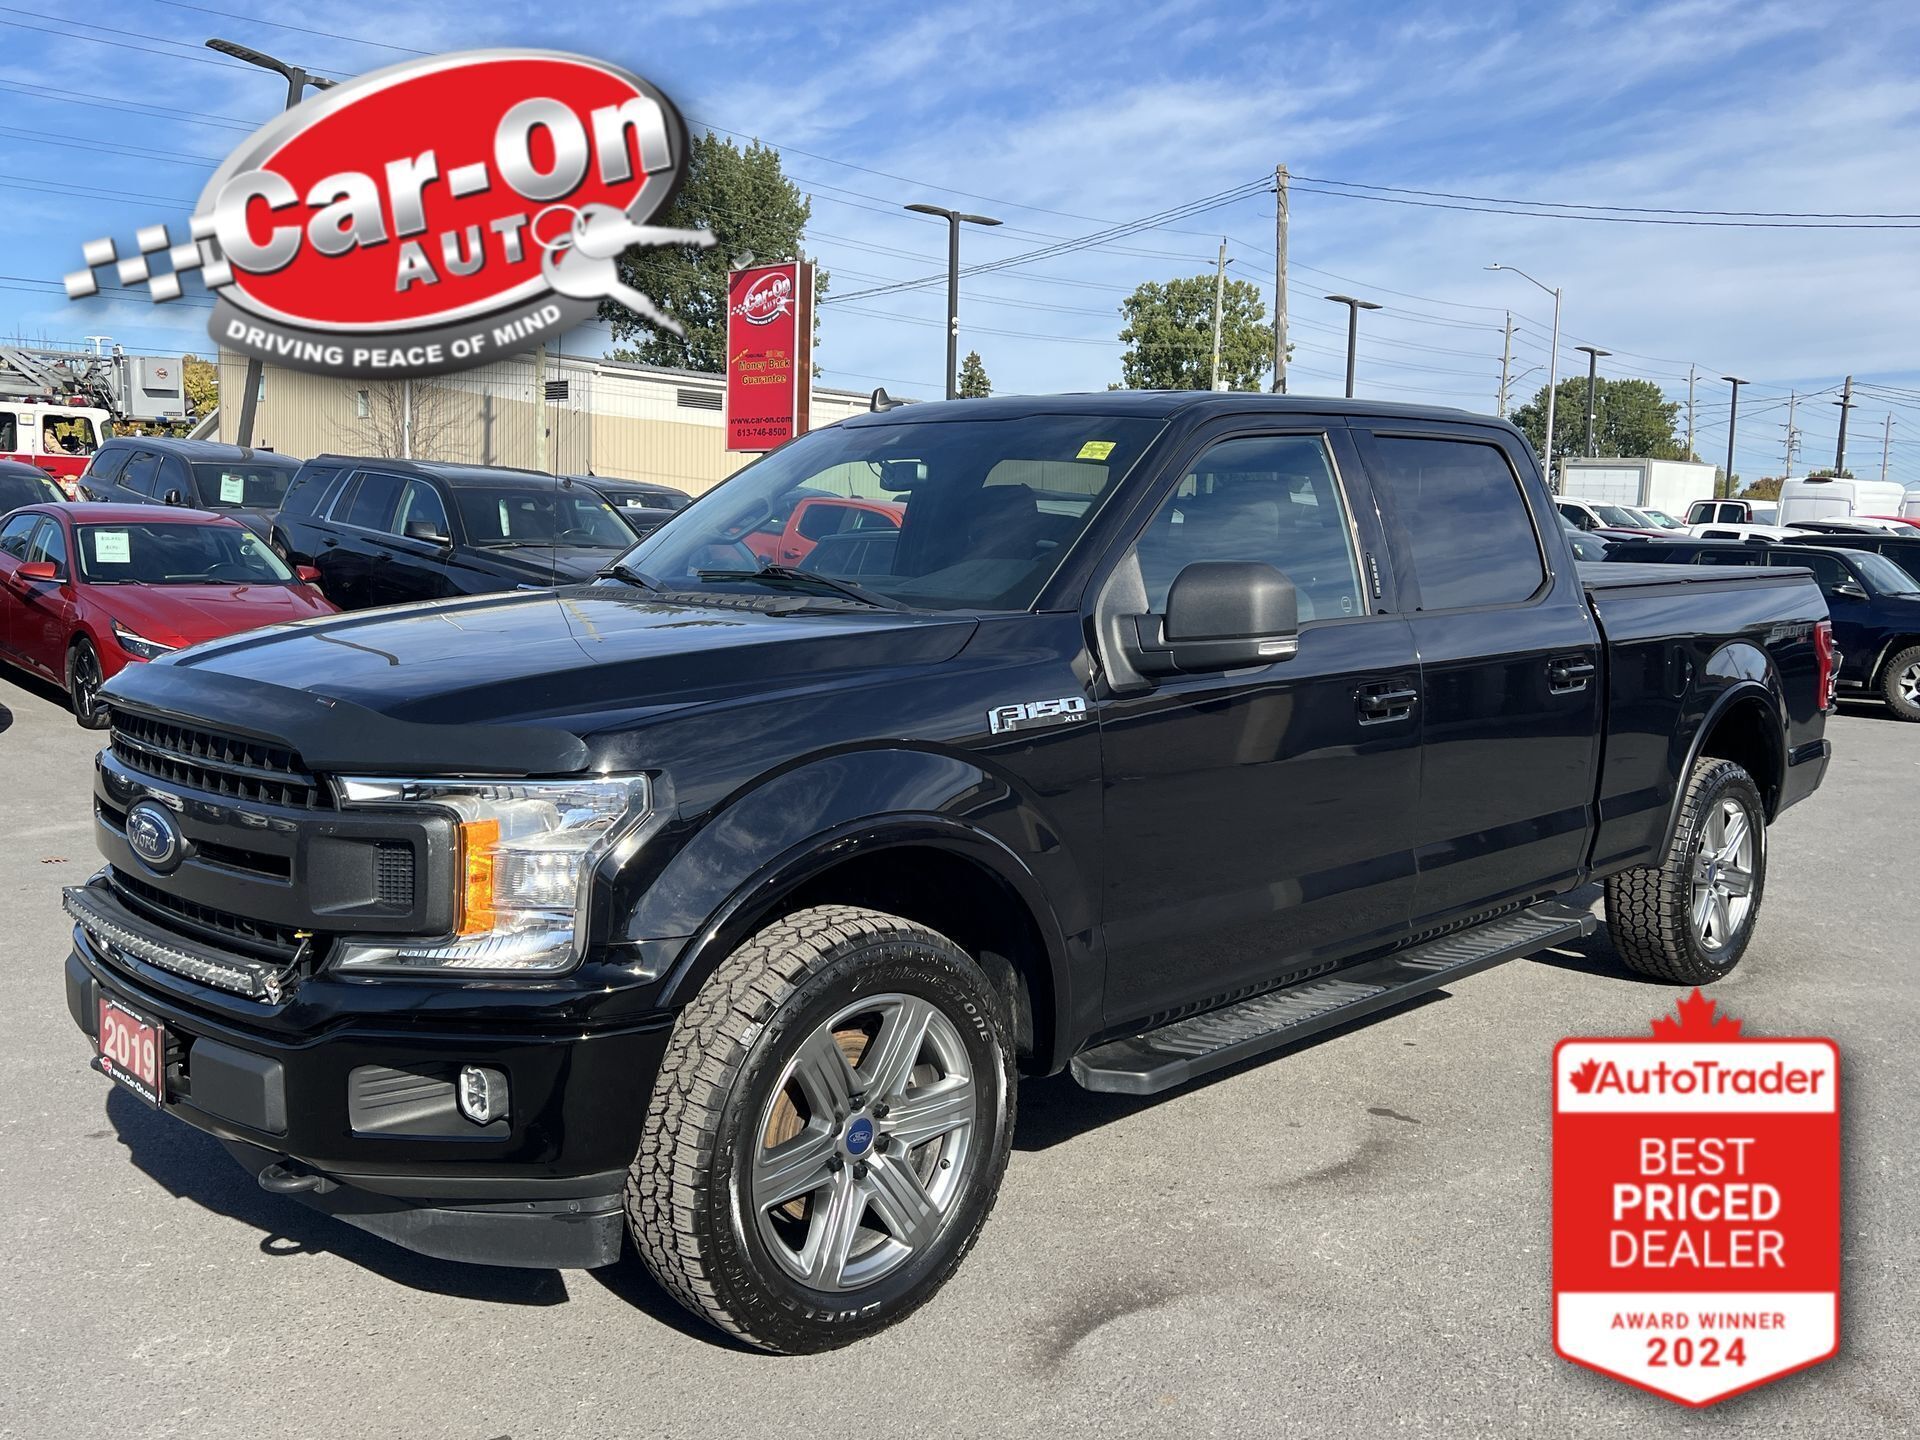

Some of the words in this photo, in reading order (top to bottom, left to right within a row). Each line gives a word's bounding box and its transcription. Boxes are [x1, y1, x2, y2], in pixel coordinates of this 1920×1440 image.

[744, 279, 791, 312] Car-On
[739, 361, 766, 372] Money
[768, 358, 790, 369] Back
[742, 374, 786, 385] Guarantee
[730, 416, 792, 424] www.car-on.com
[737, 428, 787, 437] 613-746-8500
[1064, 713, 1084, 722] XLT
[133, 819, 158, 852] Ford
[104, 1016, 156, 1083] 2019
